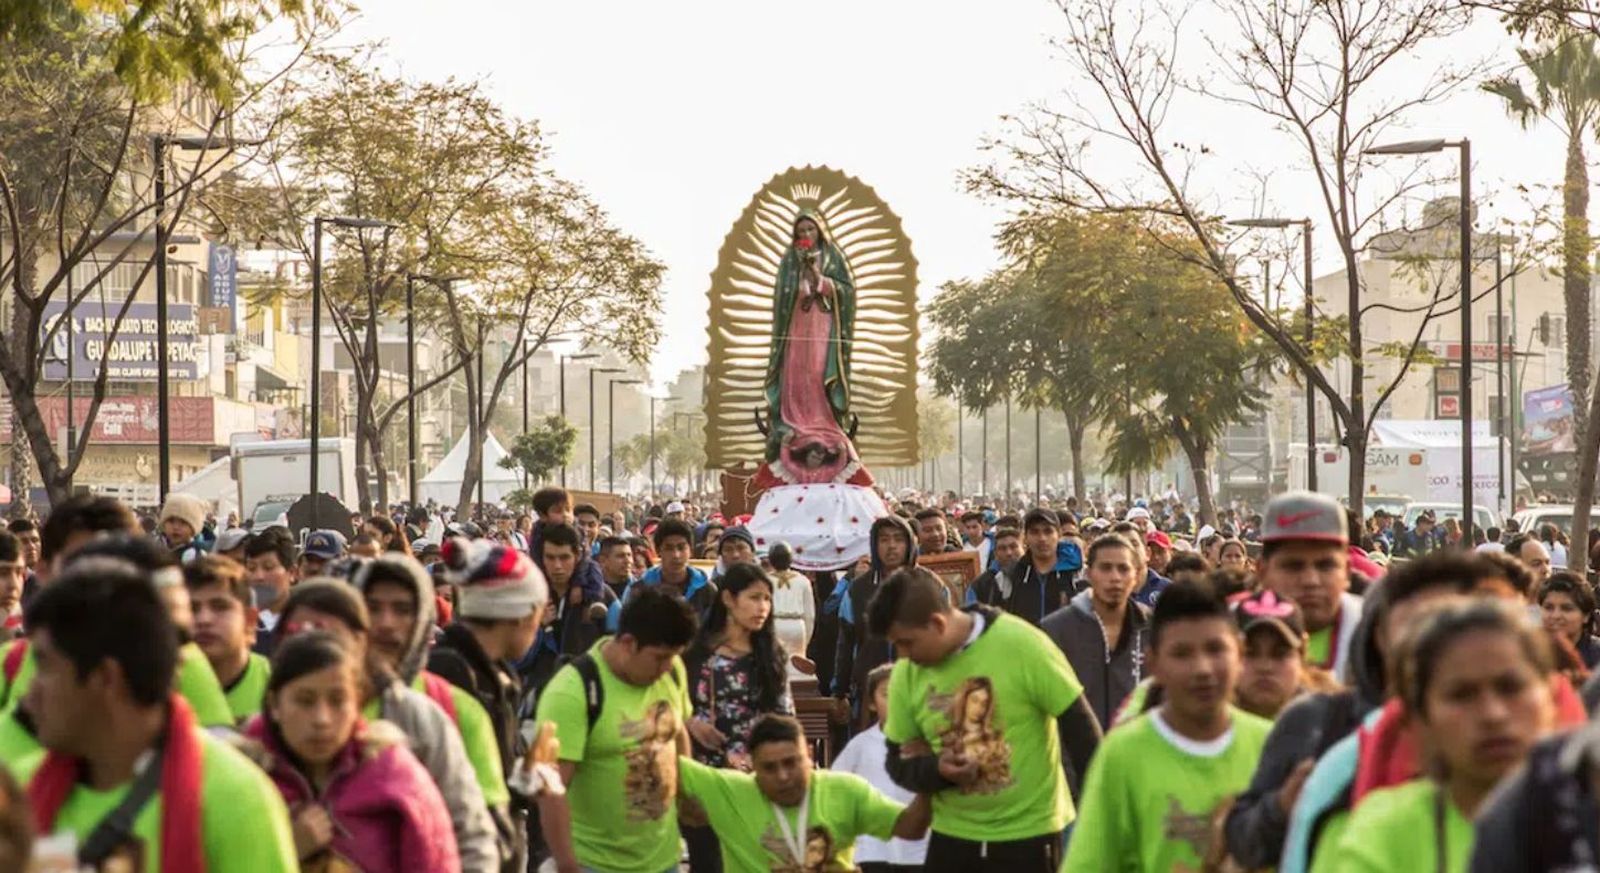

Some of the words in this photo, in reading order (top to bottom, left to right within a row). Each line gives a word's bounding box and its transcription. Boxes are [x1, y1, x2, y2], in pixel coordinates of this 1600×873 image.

[85, 318, 139, 333] BACHILRATO
[141, 318, 197, 335] TECLOGICO
[86, 339, 152, 361] GUDALUPE
[153, 341, 197, 361] TPEYAC
[1456, 480, 1500, 489] MXICO
